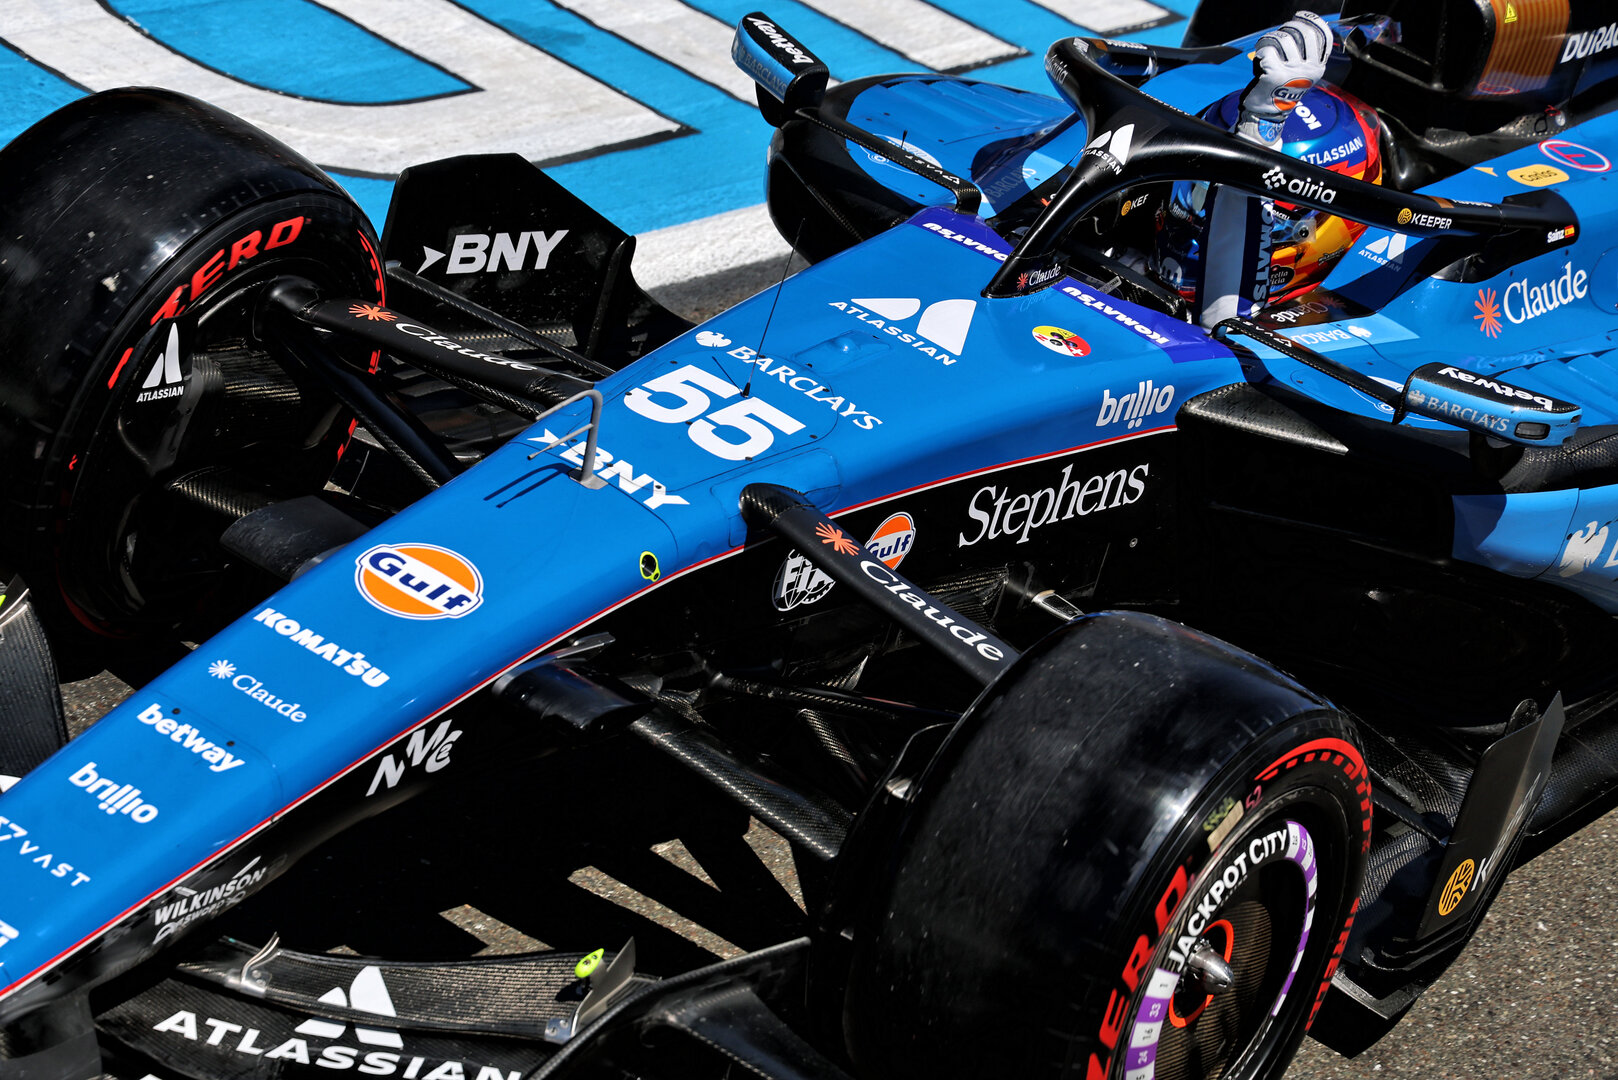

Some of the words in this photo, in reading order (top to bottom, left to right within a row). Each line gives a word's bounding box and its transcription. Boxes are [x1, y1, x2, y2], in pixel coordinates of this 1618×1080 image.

[1274, 88, 1304, 101] Gul
[1288, 177, 1336, 204] airia
[923, 222, 1009, 261] OMATSU
[1411, 213, 1452, 230] KEEPER
[1547, 230, 1565, 243] Sainz
[446, 229, 570, 275] BNY
[1029, 263, 1061, 286] Claude
[1358, 249, 1402, 272] ATLASSIAN
[1062, 286, 1170, 345] KOMATSU
[1504, 261, 1588, 324] Claude
[396, 323, 538, 371] Claude
[829, 301, 957, 366] ATLASSIAN
[136, 386, 184, 402] ATLASSIAN
[624, 364, 806, 461] 55
[726, 346, 883, 430] BARCLAYS
[1427, 396, 1511, 432] BARCLAYS
[1437, 366, 1554, 411] betway
[559, 441, 690, 510] BNY
[958, 463, 1149, 548] Stephens
[369, 552, 472, 610] Gulf
[860, 560, 1004, 661] Claude
[253, 607, 390, 687] KOMATSU
[232, 674, 307, 722] Claude
[136, 703, 245, 772] betway
[154, 867, 267, 926] WILKINSON
[1168, 852, 1247, 972] JACKPOT
[1249, 829, 1287, 864] CITY
